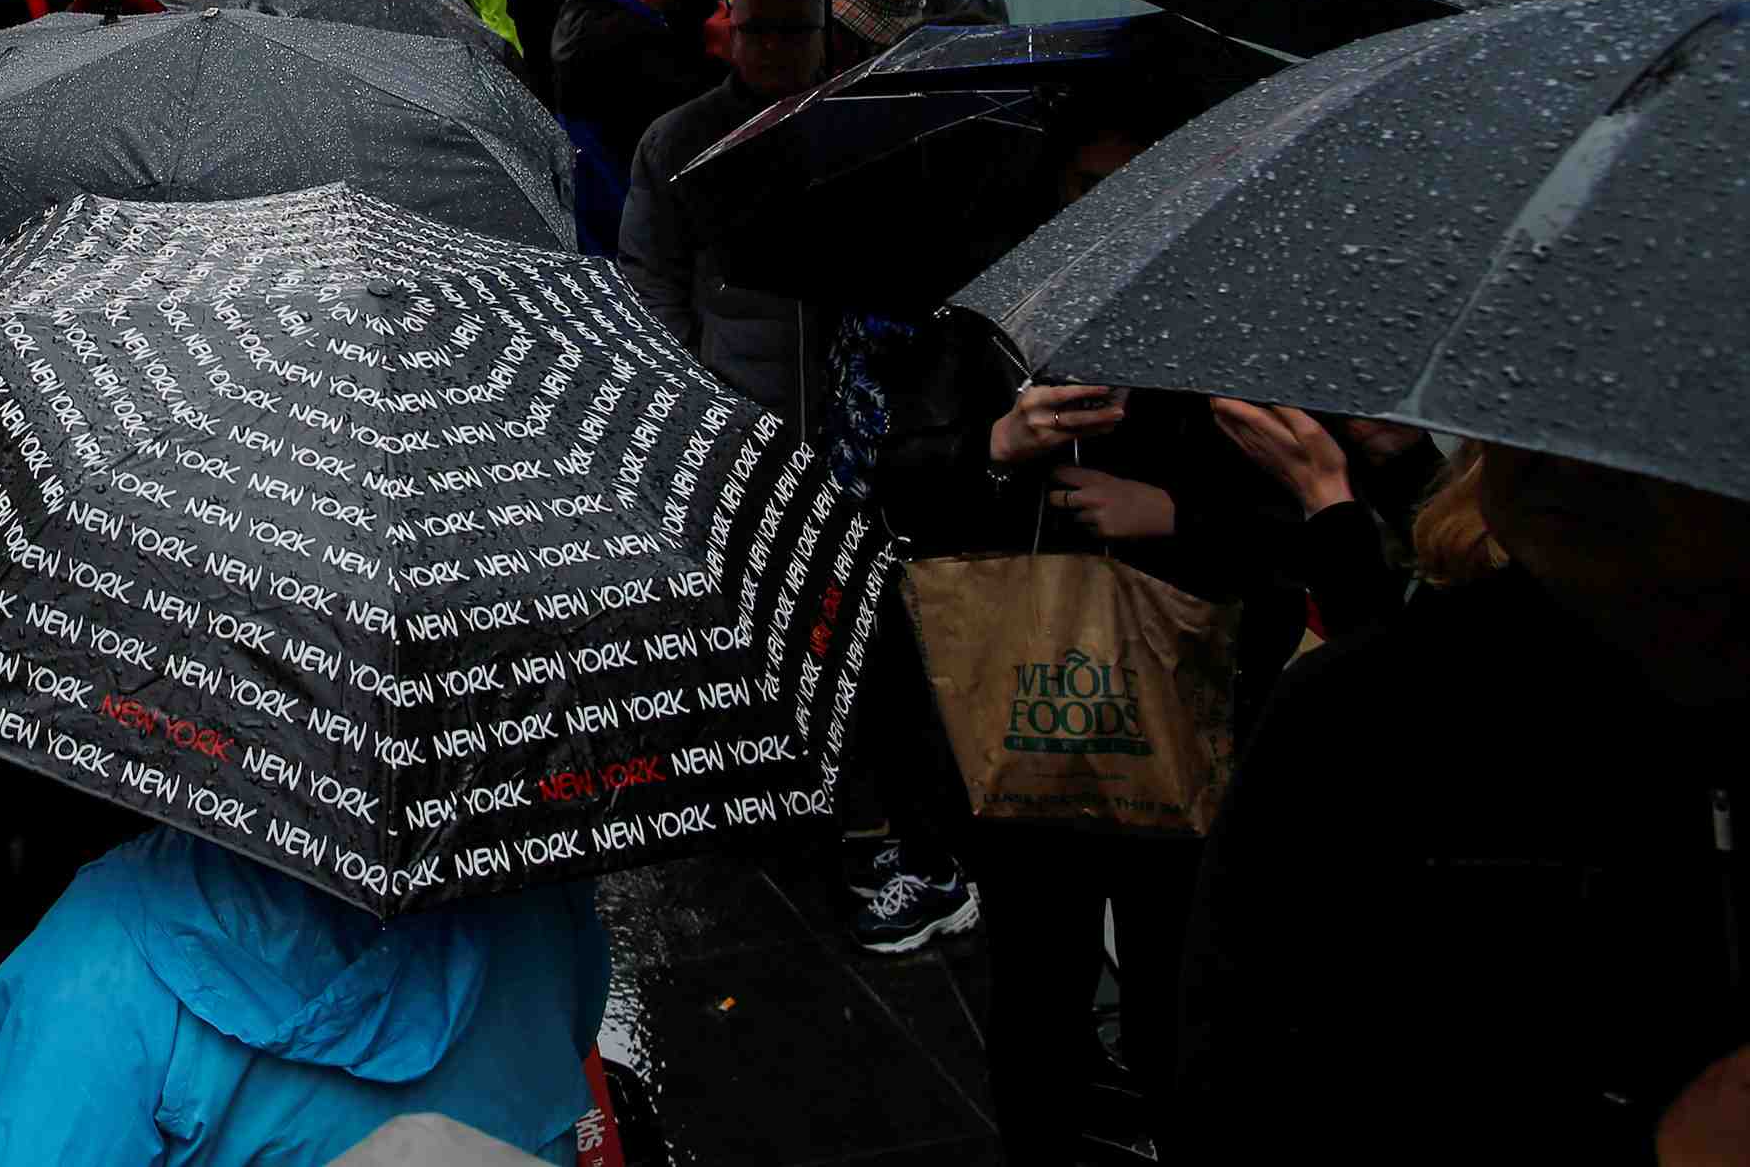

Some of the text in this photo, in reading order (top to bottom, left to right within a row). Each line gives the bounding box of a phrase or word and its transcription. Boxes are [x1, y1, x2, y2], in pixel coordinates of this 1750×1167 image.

[18, 431, 52, 479] YORK
[175, 445, 377, 531] YORK NEW YORK
[228, 426, 355, 481] NEW YORK
[428, 460, 550, 493] NEW YORK
[111, 469, 381, 579] YORK NEW YORK NEW
[415, 494, 613, 537] YORK NEW YORK
[66, 500, 337, 615] NEW YORK NEW YORK
[400, 540, 600, 588] YORK NEW YORK
[68, 558, 342, 681] YORK NEW YORK NEW
[406, 578, 660, 641] NEW YORK NEW YORK
[26, 603, 367, 752] NEW YORK NEW YORK NEW
[437, 627, 698, 696] YORK NEW YORK NEW
[1014, 662, 1139, 700] WHOLE
[27, 661, 93, 708] YORK
[100, 693, 158, 734] NEW
[166, 715, 234, 762] YORK
[242, 746, 302, 791] NEW
[310, 770, 379, 824] YORK
[434, 676, 750, 759] NEW YORK NEW YORK NEW
[1007, 699, 1144, 736] FOODS
[47, 729, 115, 778] YORK
[121, 761, 179, 803] NEW
[187, 784, 257, 835] YORK
[266, 819, 327, 866] NEW
[463, 735, 796, 815] YORK NEW YORK
[455, 791, 776, 879] NEW YORK NEW YORK NEW
